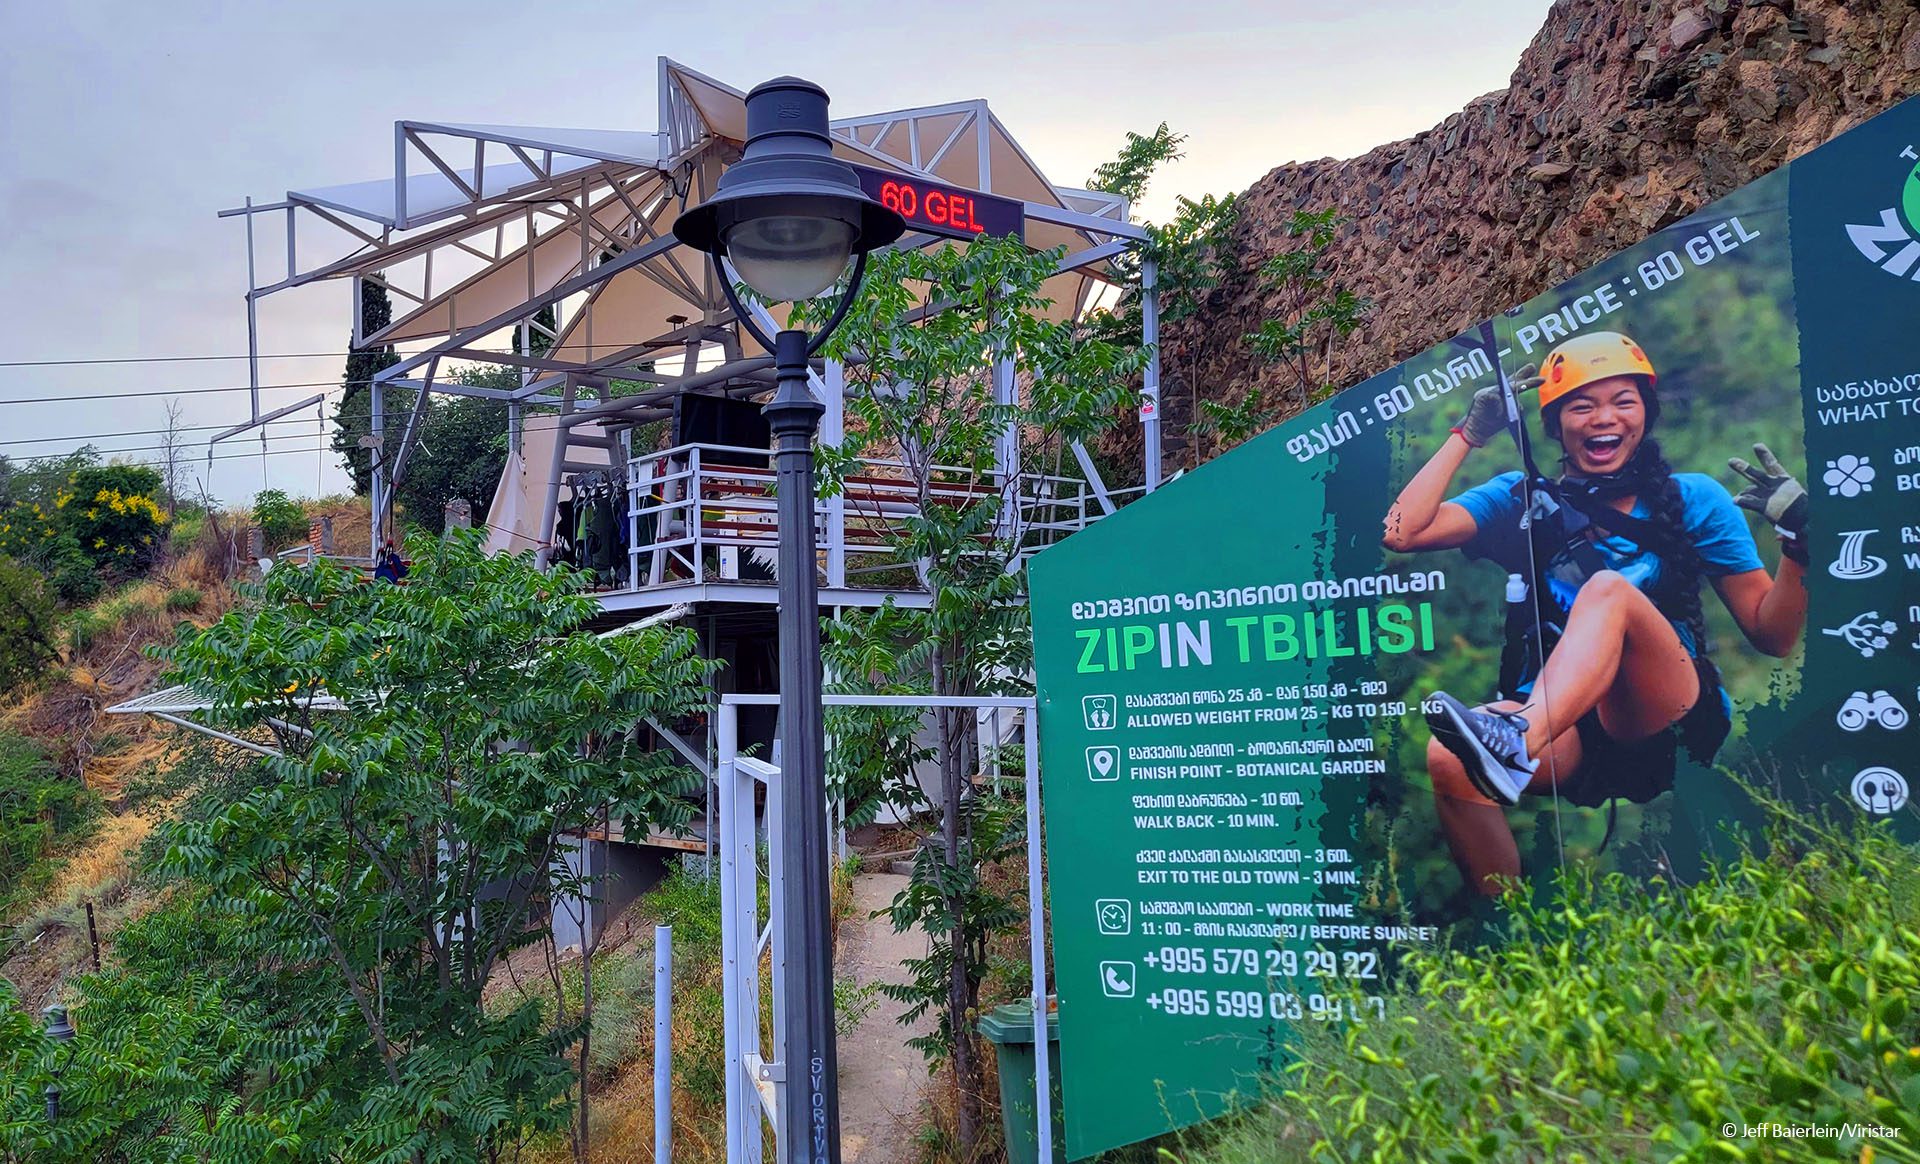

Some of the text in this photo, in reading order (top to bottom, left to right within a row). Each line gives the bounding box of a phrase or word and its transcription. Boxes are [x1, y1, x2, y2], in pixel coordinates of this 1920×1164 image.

[880, 180, 984, 233] 60 GEL
[1286, 410, 1361, 463] ფასი
[1373, 384, 1415, 421] 60
[1413, 347, 1493, 401] ლარი
[1516, 282, 1623, 355] PRICE
[1638, 250, 1684, 291] 60
[1685, 217, 1761, 266] GEL
[1818, 402, 1890, 426] WHAT
[1072, 570, 1446, 620] დაეშვით ზიპინით თბილისში
[1075, 602, 1435, 673] ZIPIN TBILISI
[1126, 692, 1190, 708] დასაშვები
[1193, 690, 1226, 705] წონა
[1228, 689, 1244, 703] 25
[1276, 685, 1300, 700] დან
[1303, 684, 1328, 699] 150
[1361, 681, 1387, 696] მდე
[1127, 712, 1192, 728] ALLOWED
[1195, 709, 1251, 725] WEIGHT
[1255, 707, 1297, 722] FROM
[1301, 706, 1318, 720] 25
[1332, 704, 1353, 719] KG
[1355, 703, 1376, 718] TO
[1379, 701, 1406, 717] 150
[1421, 700, 1444, 715] KG
[1129, 745, 1187, 760] დაშვების
[1189, 743, 1234, 758] ადგილი
[1248, 739, 1335, 756] ბოტანიკური
[1338, 738, 1374, 753] ბაღი
[1130, 766, 1177, 780] FINISH
[1180, 764, 1222, 779] POINT
[1237, 762, 1318, 777] BOTANICAL
[1322, 759, 1386, 775] GARDEN
[1132, 795, 1175, 809] ფეხით
[1177, 793, 1248, 808] დაბრუნება
[1261, 792, 1277, 806] 10
[1133, 815, 1174, 829] WALK
[1176, 814, 1215, 828] BACK
[1227, 814, 1244, 828] 10
[1246, 813, 1279, 827] MIN.
[1136, 849, 1166, 864] ძველ
[1169, 849, 1221, 863] ქალაქში
[1223, 849, 1301, 864] გასასვლელი
[1315, 849, 1324, 863] 3
[1138, 870, 1168, 884] EXIT
[1170, 870, 1189, 884] TO
[1192, 870, 1220, 884] THE
[1222, 870, 1251, 884] OLD
[1253, 870, 1299, 884] TOWN
[1314, 870, 1323, 885] 3
[1325, 870, 1361, 885] MIN.
[1140, 901, 1195, 915] სამუშაო
[1197, 901, 1254, 916] საათები
[1266, 903, 1314, 917] WORK
[1316, 903, 1354, 918] TIME
[1193, 922, 1225, 937] მზის
[1227, 923, 1297, 938] ჩასვლამდე
[1310, 925, 1371, 940] BEFORE
[1374, 926, 1439, 941] SUNSET
[1143, 946, 1377, 979] +995 579 29 29 22
[1146, 988, 1210, 1016] +995
[1216, 990, 1264, 1019] 599
